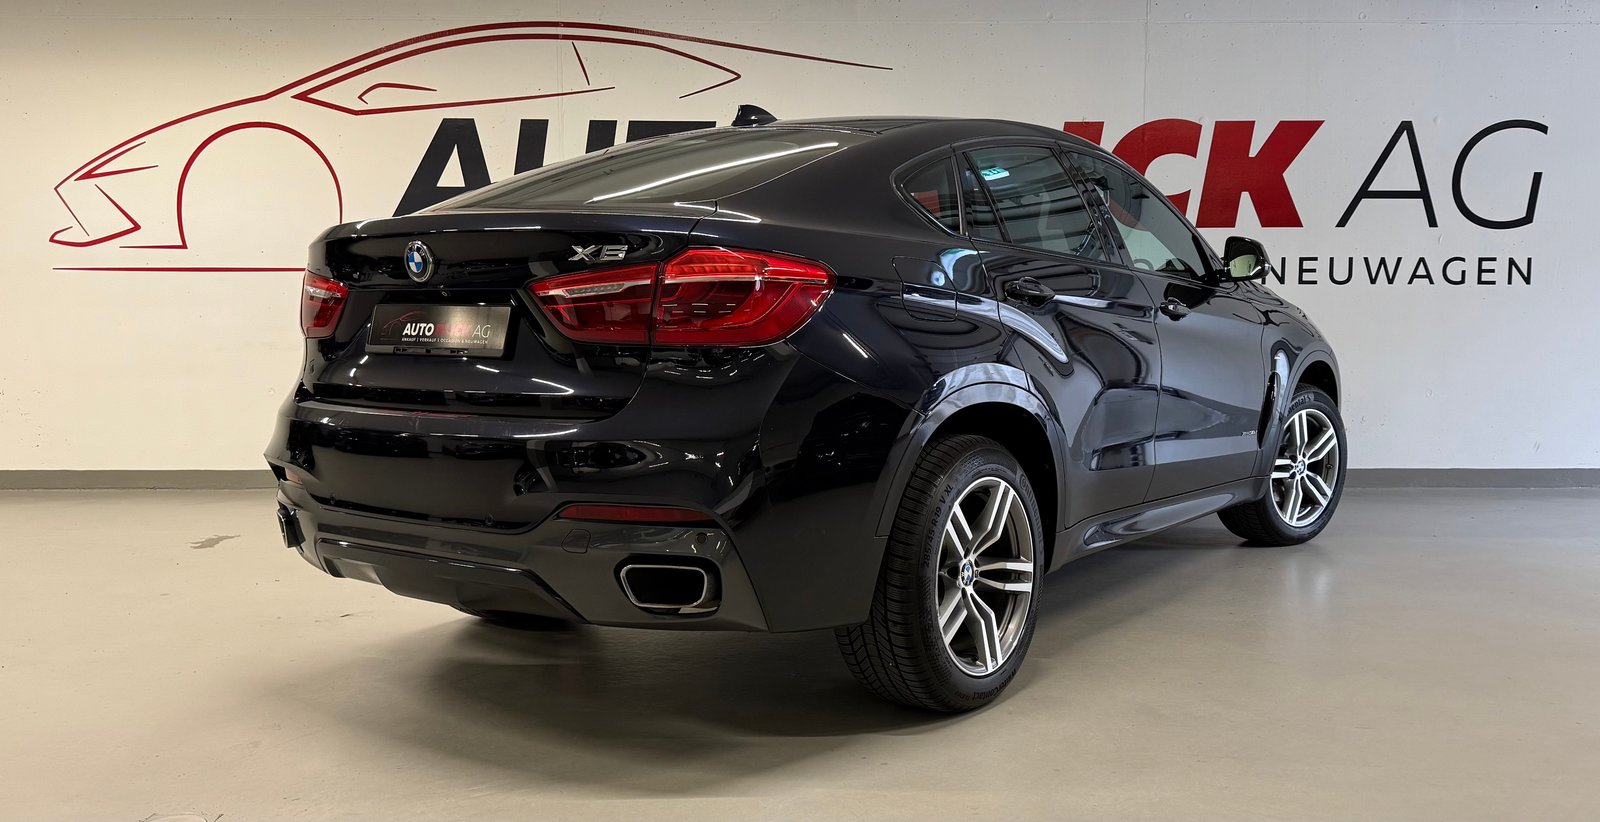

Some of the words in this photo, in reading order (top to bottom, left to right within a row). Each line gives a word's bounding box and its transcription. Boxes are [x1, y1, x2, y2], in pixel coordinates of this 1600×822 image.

[1335, 119, 1549, 230] AG
[568, 244, 628, 261] X6
[1263, 256, 1534, 286] NEUWAGEN
[402, 322, 435, 336] AUTO
[471, 324, 492, 338] AG
